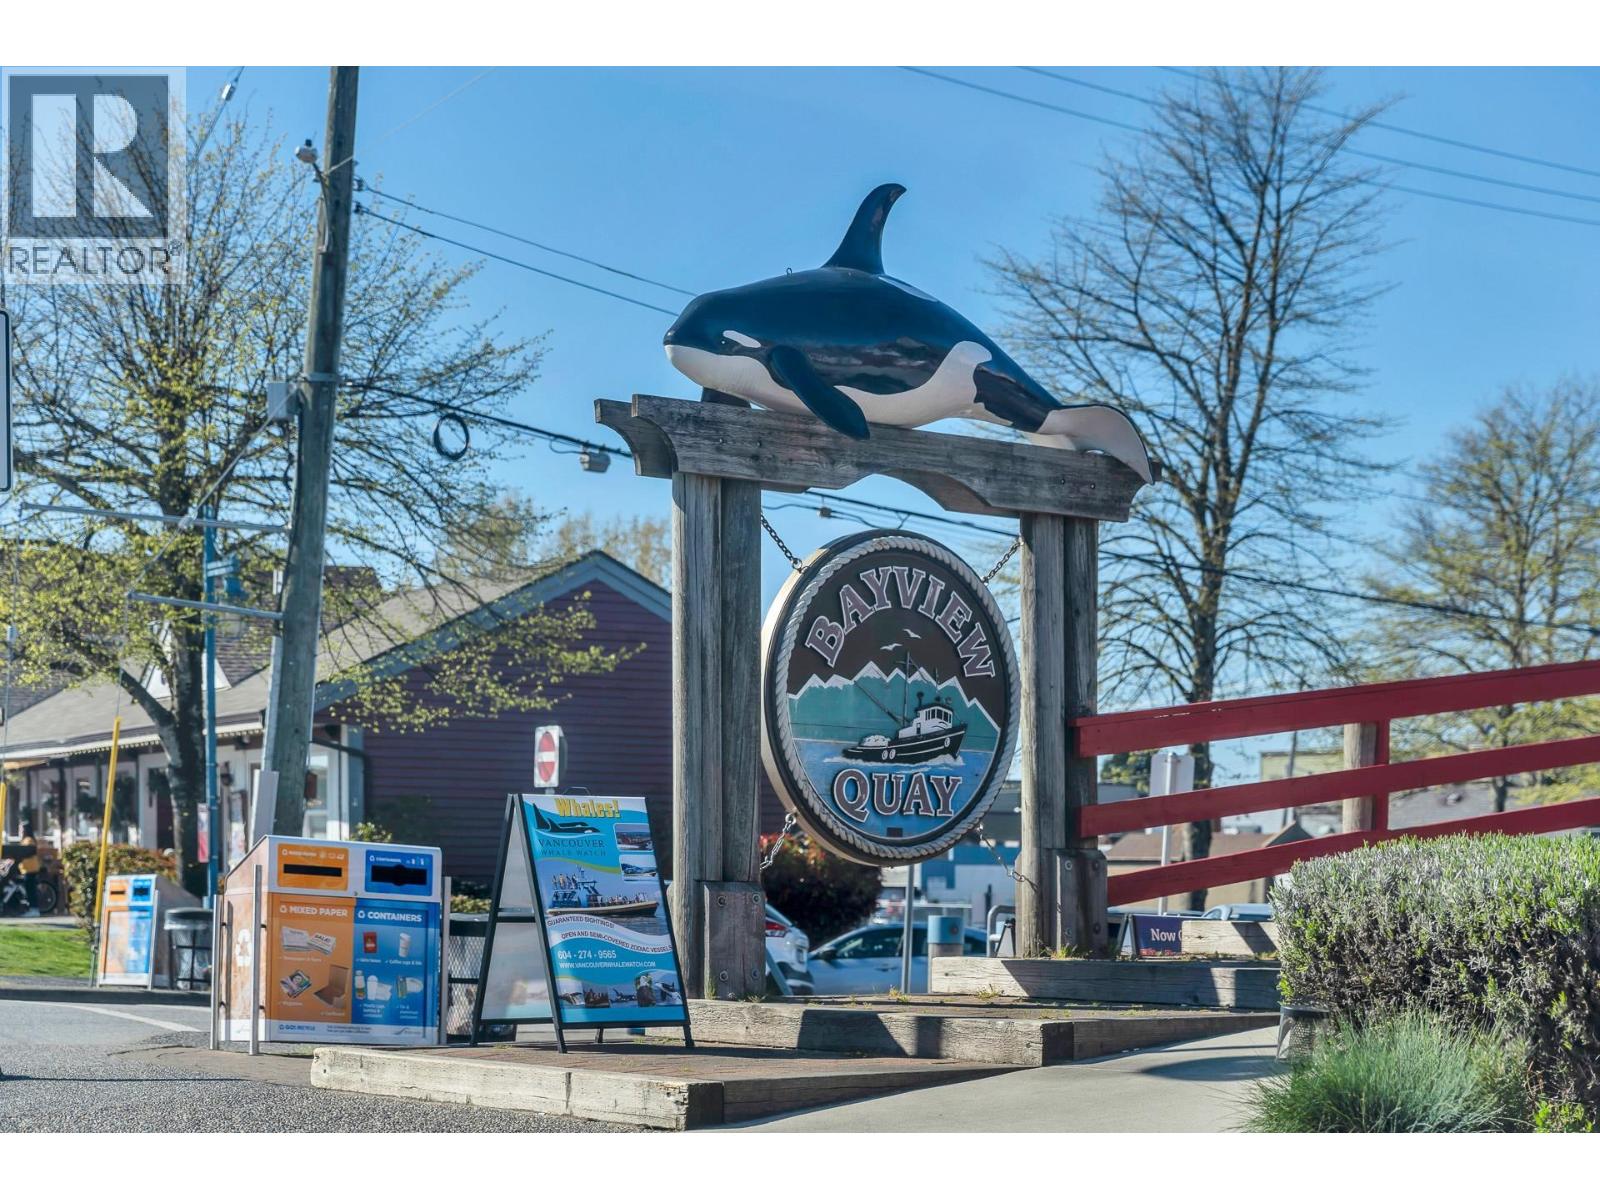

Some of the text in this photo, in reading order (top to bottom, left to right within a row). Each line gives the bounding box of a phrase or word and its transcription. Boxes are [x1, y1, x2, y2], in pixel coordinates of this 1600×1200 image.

[805, 566, 995, 678] BAYVIEW
[834, 769, 962, 823] QUAY
[554, 798, 621, 818] Whales!
[540, 839, 605, 848] VANCOUVER
[541, 849, 574, 857] WHALE
[289, 905, 348, 917] MIXED PAPER
[367, 911, 422, 923] CONTAINERS
[547, 915, 584, 927] GUARANTEED
[1151, 928, 1176, 942] Now
[561, 931, 577, 939] OPEN
[650, 944, 673, 953] VESSELS
[557, 950, 571, 959] 604
[578, 949, 592, 959] 274
